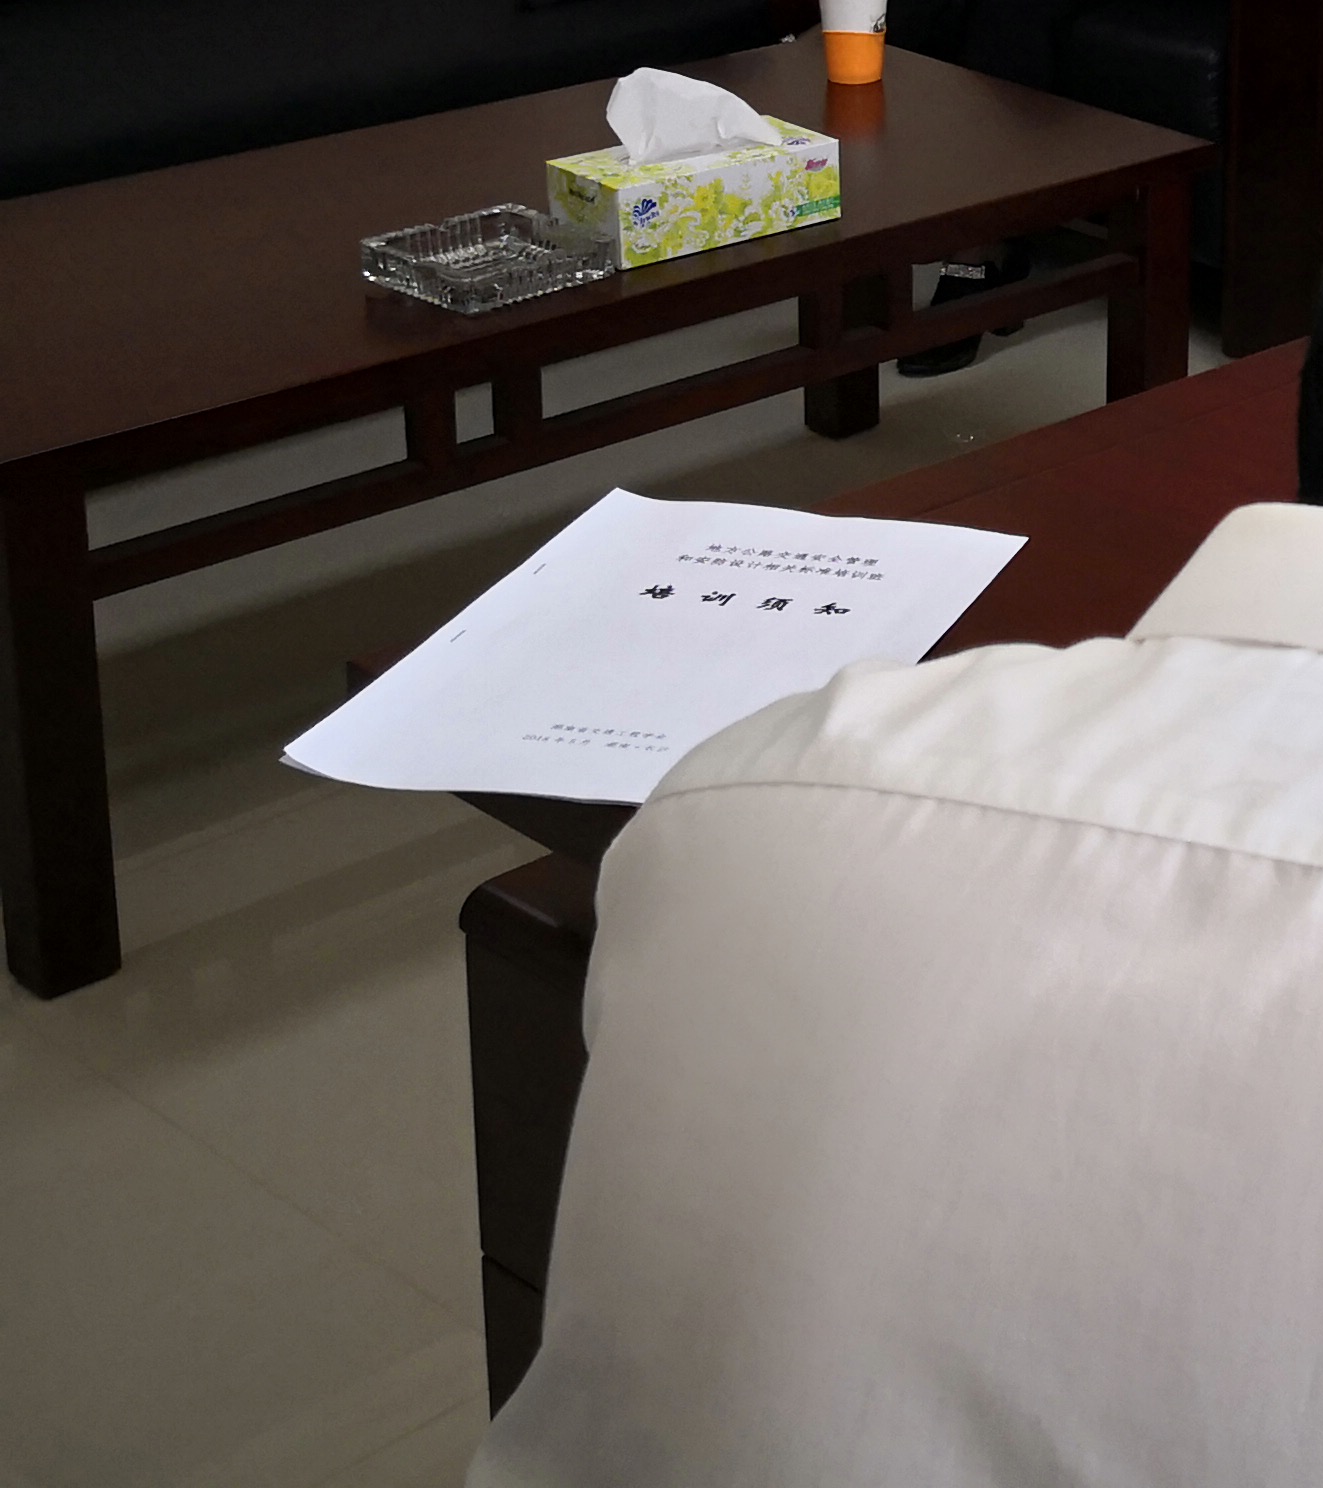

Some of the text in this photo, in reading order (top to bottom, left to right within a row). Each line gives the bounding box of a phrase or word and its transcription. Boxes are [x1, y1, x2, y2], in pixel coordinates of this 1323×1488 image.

[707, 544, 880, 566] 地方公路交通安全管理
[639, 585, 851, 615] 培训须知
